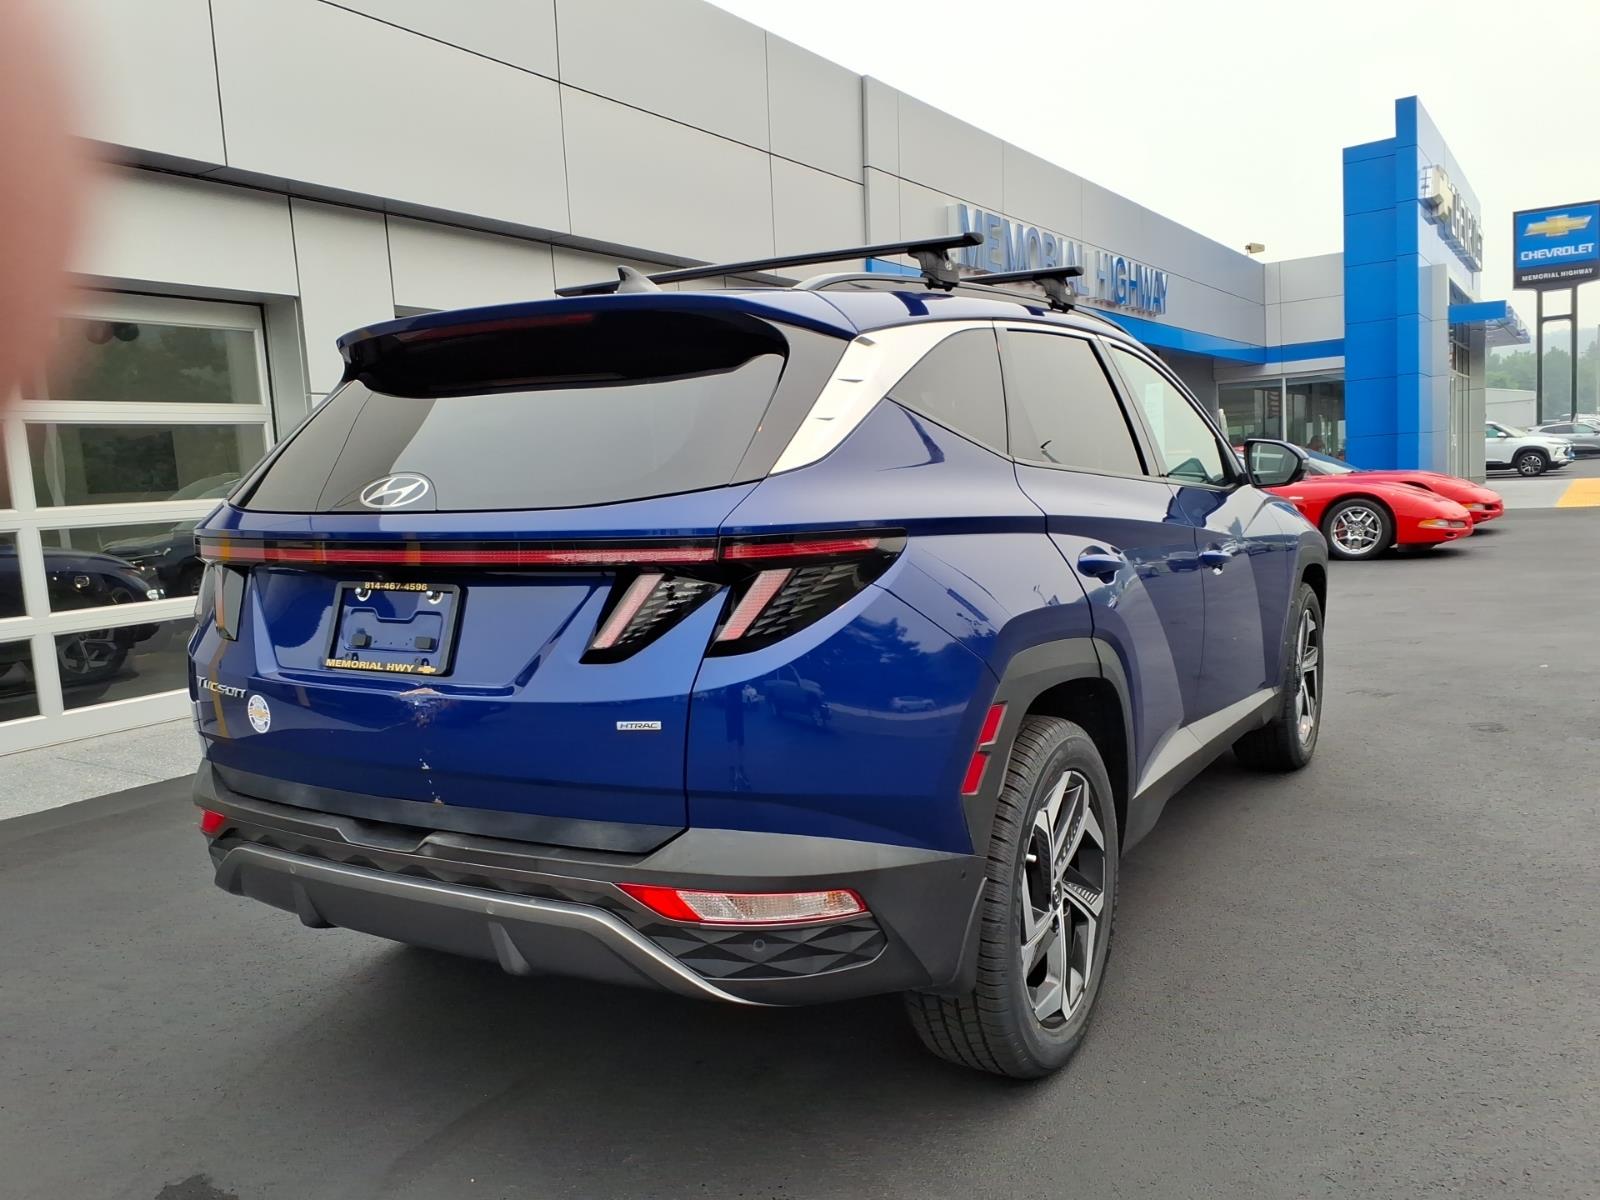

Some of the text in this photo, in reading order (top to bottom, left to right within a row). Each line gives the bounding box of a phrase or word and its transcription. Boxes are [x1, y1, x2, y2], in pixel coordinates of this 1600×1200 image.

[951, 203, 1169, 315] MEMORIAL HIGHWAY
[1520, 242, 1595, 261] CHEVROLET
[1521, 267, 1593, 281] MEMORIAL HIGHWAY
[364, 582, 428, 591] 814-467-4596
[325, 658, 415, 673] MEMORIAL HWY
